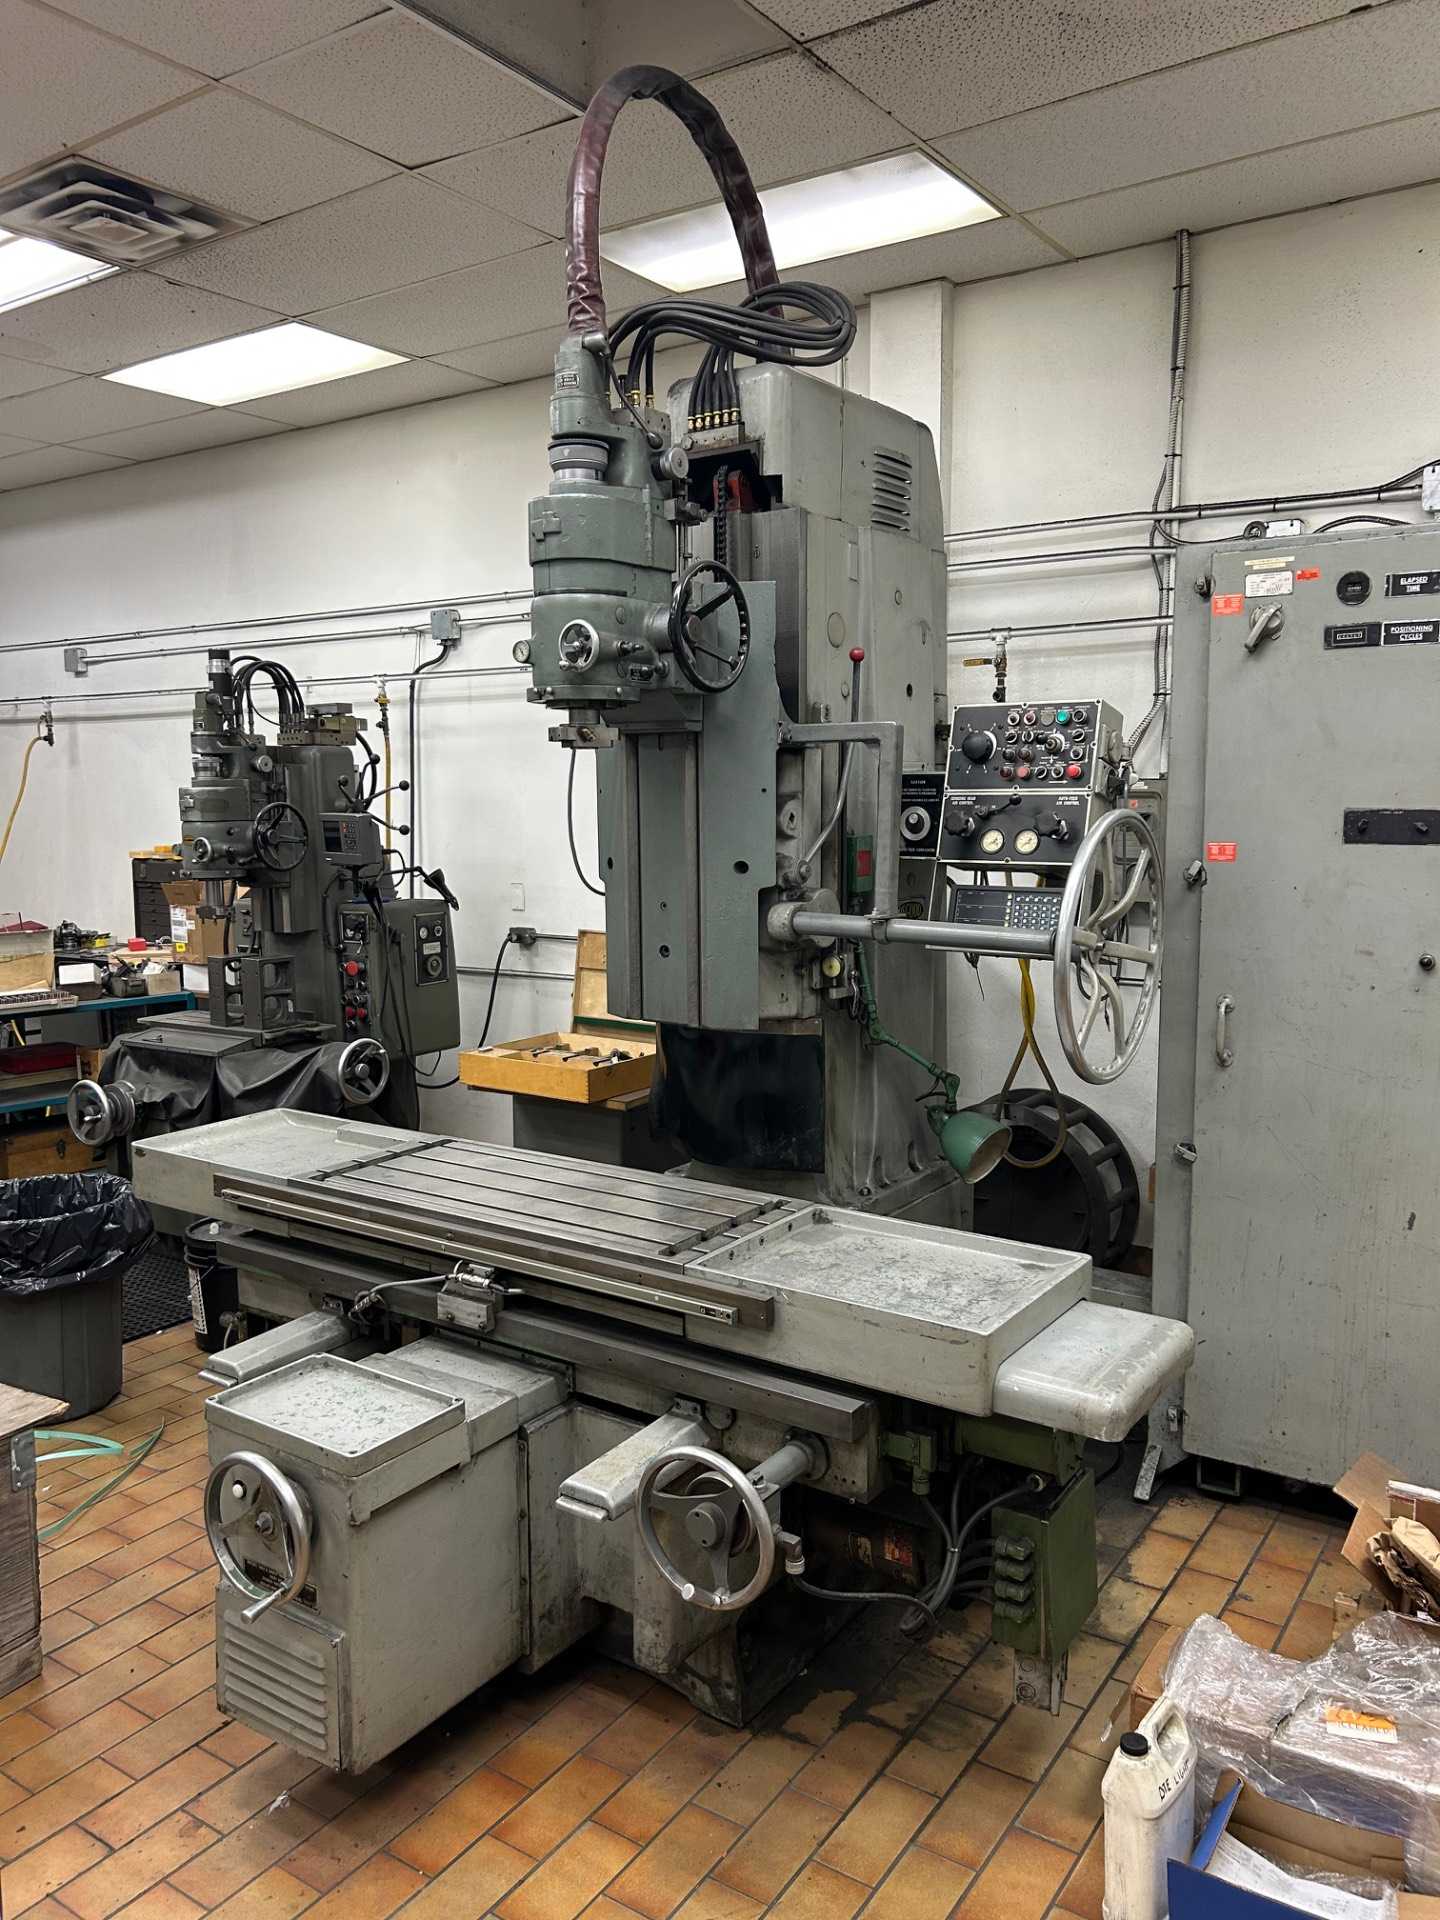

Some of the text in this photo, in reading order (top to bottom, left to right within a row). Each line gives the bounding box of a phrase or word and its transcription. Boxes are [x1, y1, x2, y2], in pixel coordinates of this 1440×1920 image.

[1400, 576, 1428, 585] ELAPSED
[1390, 625, 1433, 634] POSITIONING
[1399, 633, 1423, 641] CYCLES
